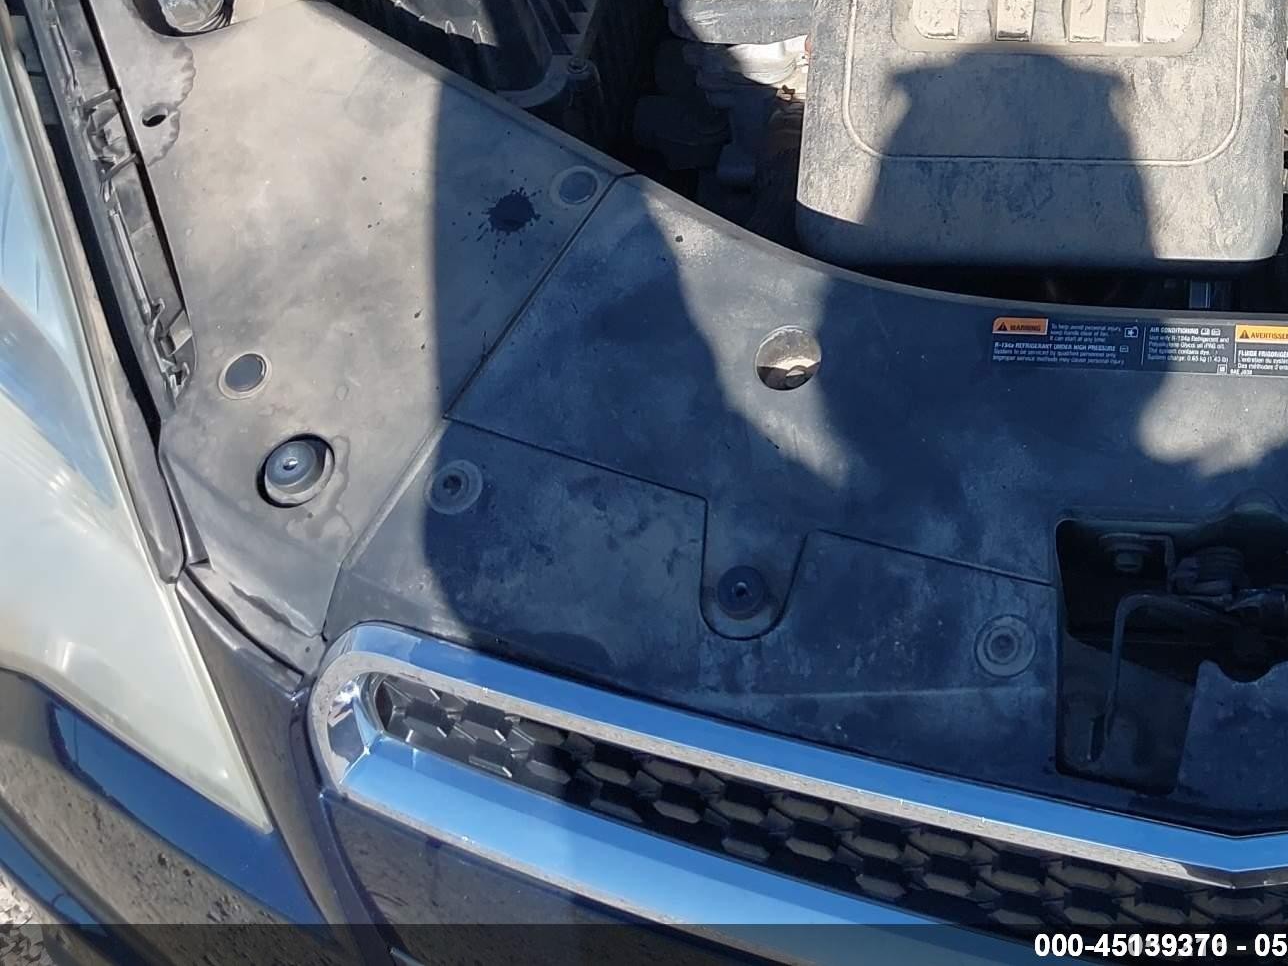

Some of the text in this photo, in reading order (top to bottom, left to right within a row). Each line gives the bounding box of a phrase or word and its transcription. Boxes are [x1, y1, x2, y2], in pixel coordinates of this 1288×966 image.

[1009, 324, 1041, 332] WARNING
[1160, 327, 1199, 335] CONDITIONING
[1015, 342, 1052, 350] REFRIGERANT
